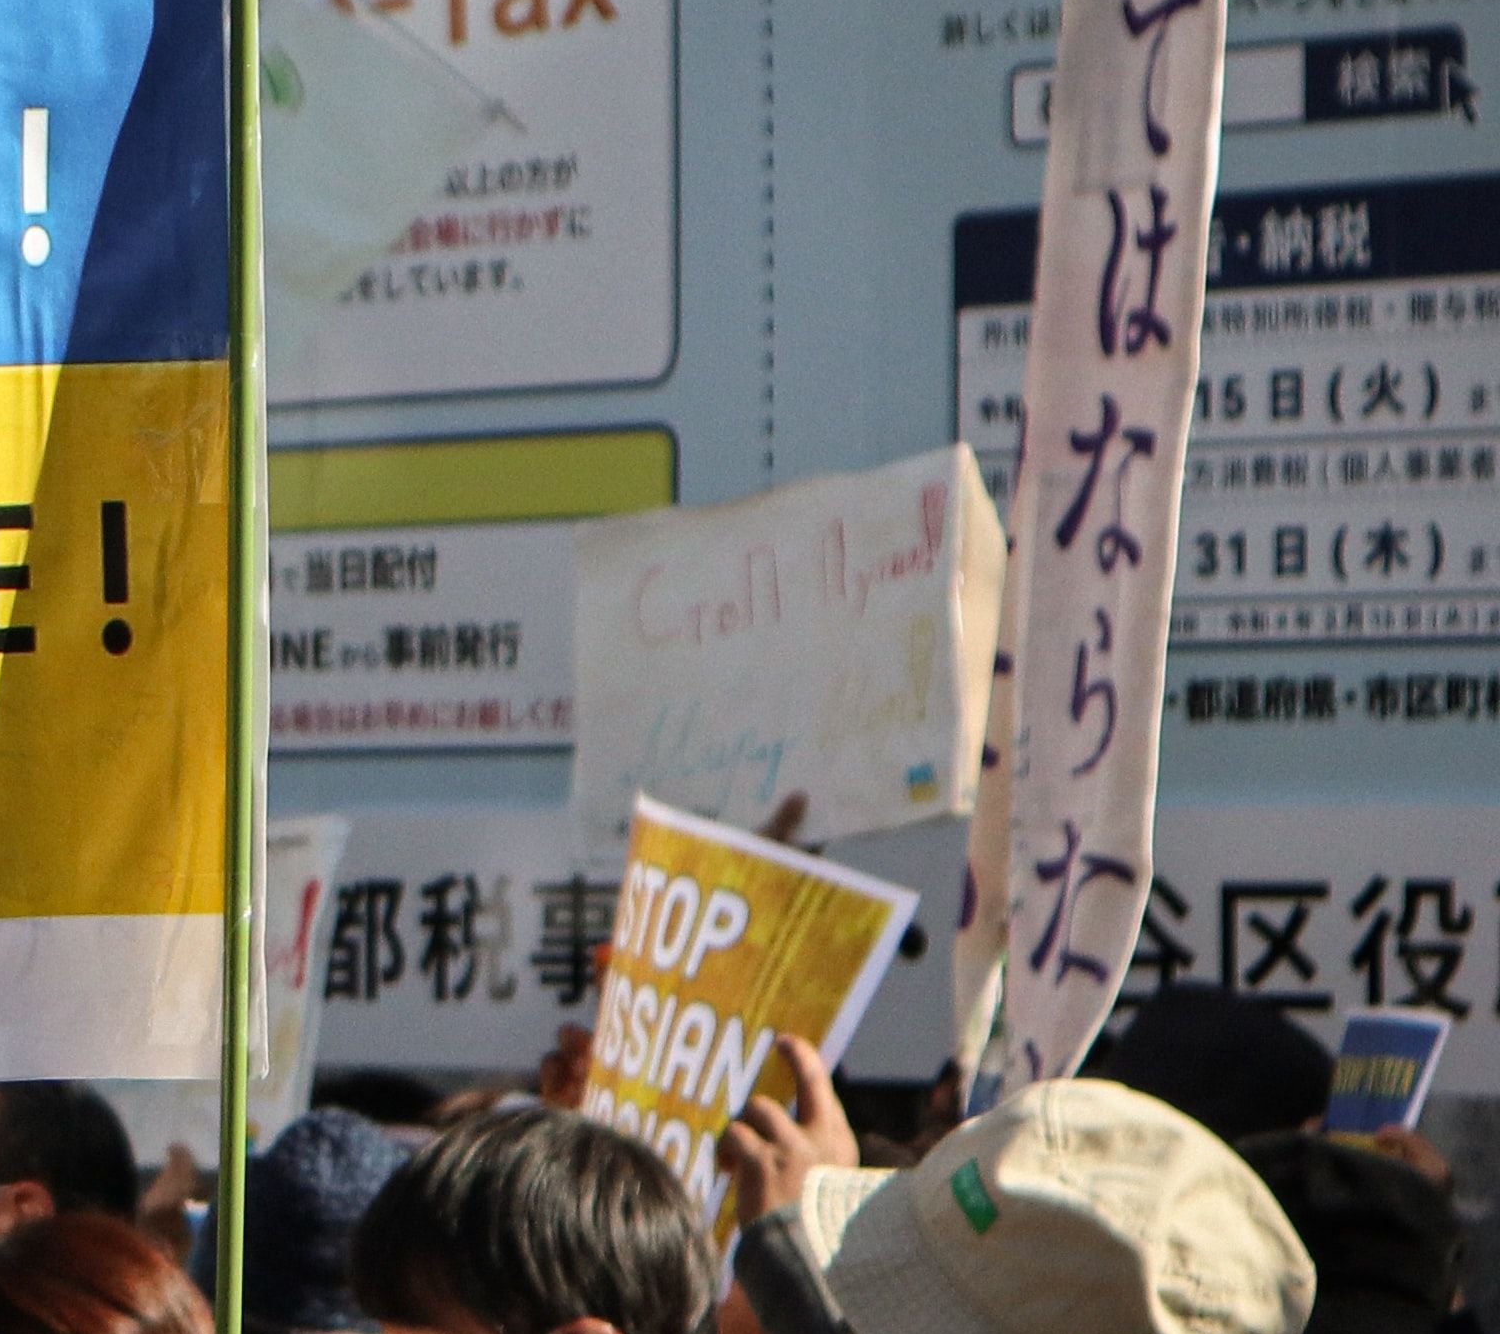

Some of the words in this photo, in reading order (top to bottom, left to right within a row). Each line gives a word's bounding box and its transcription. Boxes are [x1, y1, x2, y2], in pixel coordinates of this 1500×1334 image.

[1336, 47, 1432, 107] 検索
[338, 257, 526, 304] をしています。
[614, 859, 752, 983] STOP
